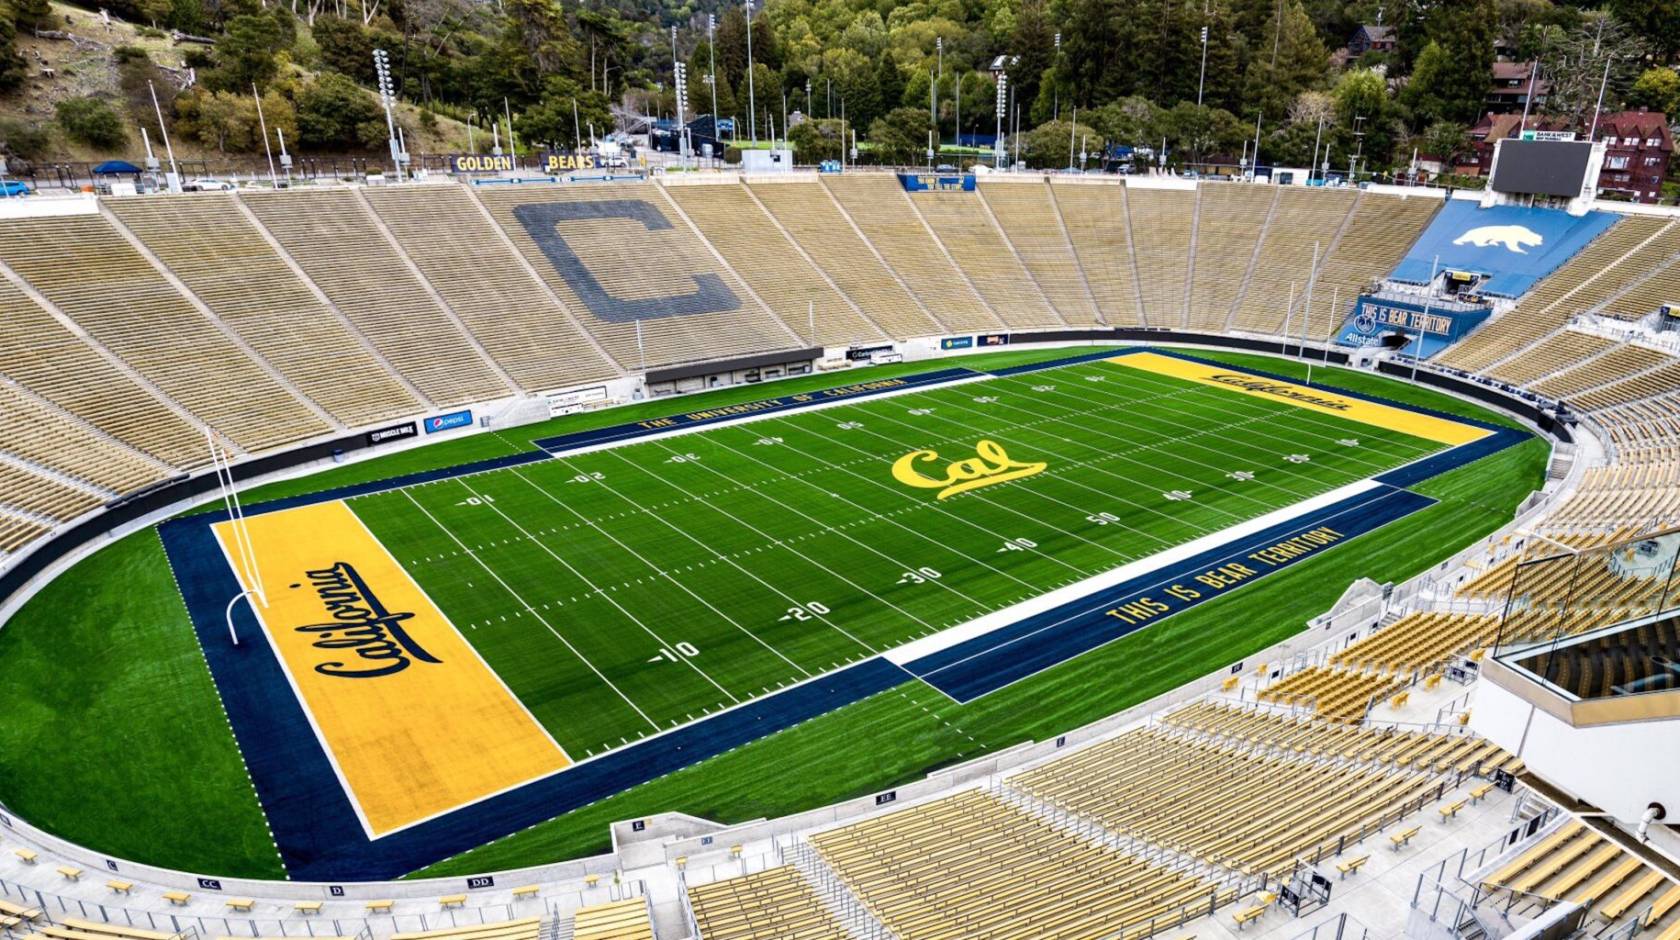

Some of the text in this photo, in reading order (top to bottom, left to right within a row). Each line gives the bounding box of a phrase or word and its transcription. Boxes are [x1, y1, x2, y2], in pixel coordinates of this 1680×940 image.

[457, 155, 594, 171] GOLDEN BEARS
[513, 199, 743, 324] C
[1361, 303, 1452, 335] THIS IS BEAR TERRITORY
[1344, 333, 1379, 346] Allstate
[637, 378, 907, 430] THE UNIVERSITY OF CALIFORNIA
[443, 416, 464, 426] pepsi
[380, 428, 399, 439] MUSCLE
[891, 439, 1048, 500] Cal
[573, 471, 607, 484] 20
[467, 494, 496, 506] 10
[1086, 511, 1121, 526] 50
[1008, 537, 1038, 552] 40
[902, 566, 943, 584] 30
[1106, 526, 1345, 625] THIS IS BEAR TERRITORY
[787, 601, 831, 622] 20
[289, 561, 444, 678] California
[658, 641, 701, 663] 10
[202, 879, 217, 888] CC
[472, 877, 489, 887] DD
[333, 886, 342, 895] D
